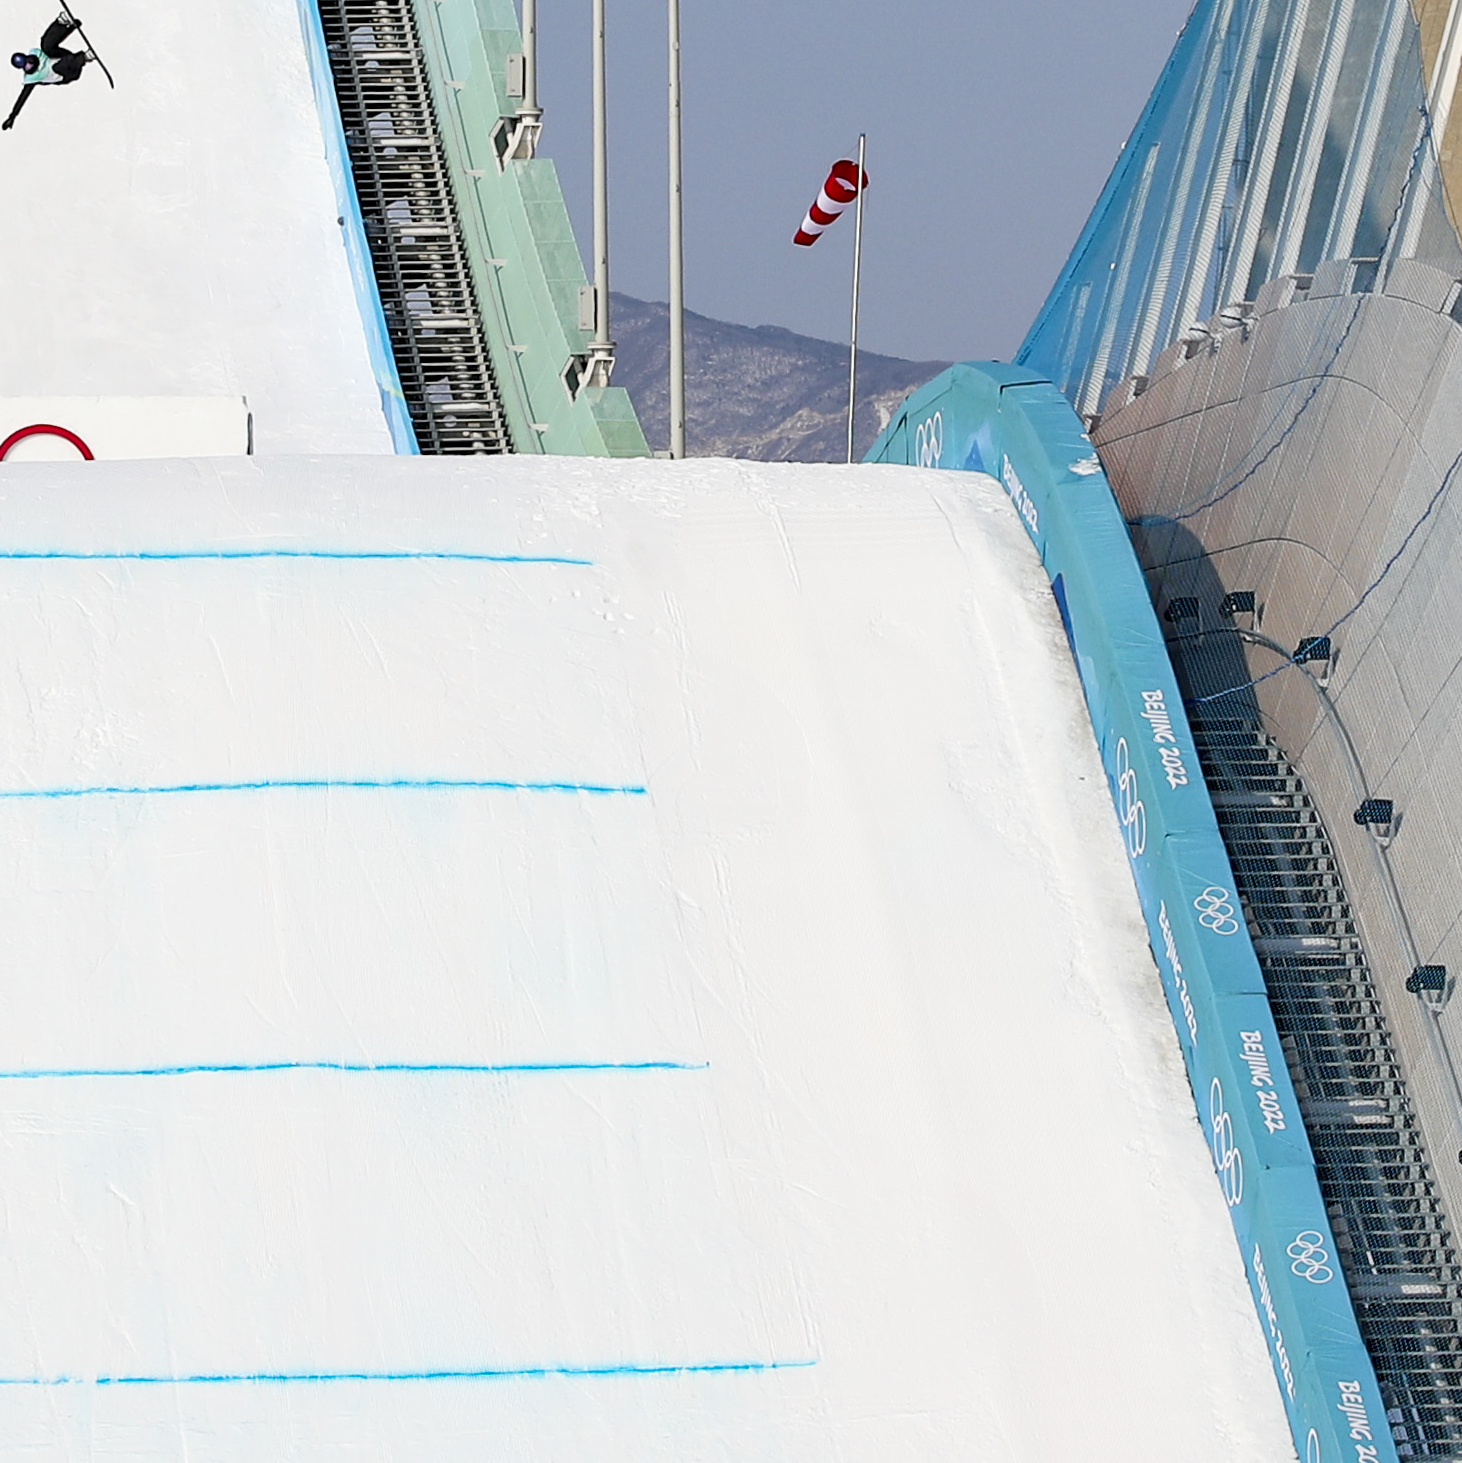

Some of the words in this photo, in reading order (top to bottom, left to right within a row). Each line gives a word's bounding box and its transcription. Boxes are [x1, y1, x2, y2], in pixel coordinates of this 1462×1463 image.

[1140, 689, 1176, 744] BEIJING
[1158, 746, 1189, 791] 2022
[1158, 899, 1183, 988] BEIJING
[1180, 979, 1198, 1048] 2022
[1239, 1030, 1274, 1087] BEIJING
[1256, 1090, 1287, 1135] 2022
[1253, 1242, 1278, 1338] BEIJING
[1275, 1319, 1295, 1404] 2022
[1337, 1380, 1373, 1441] BEIJING
